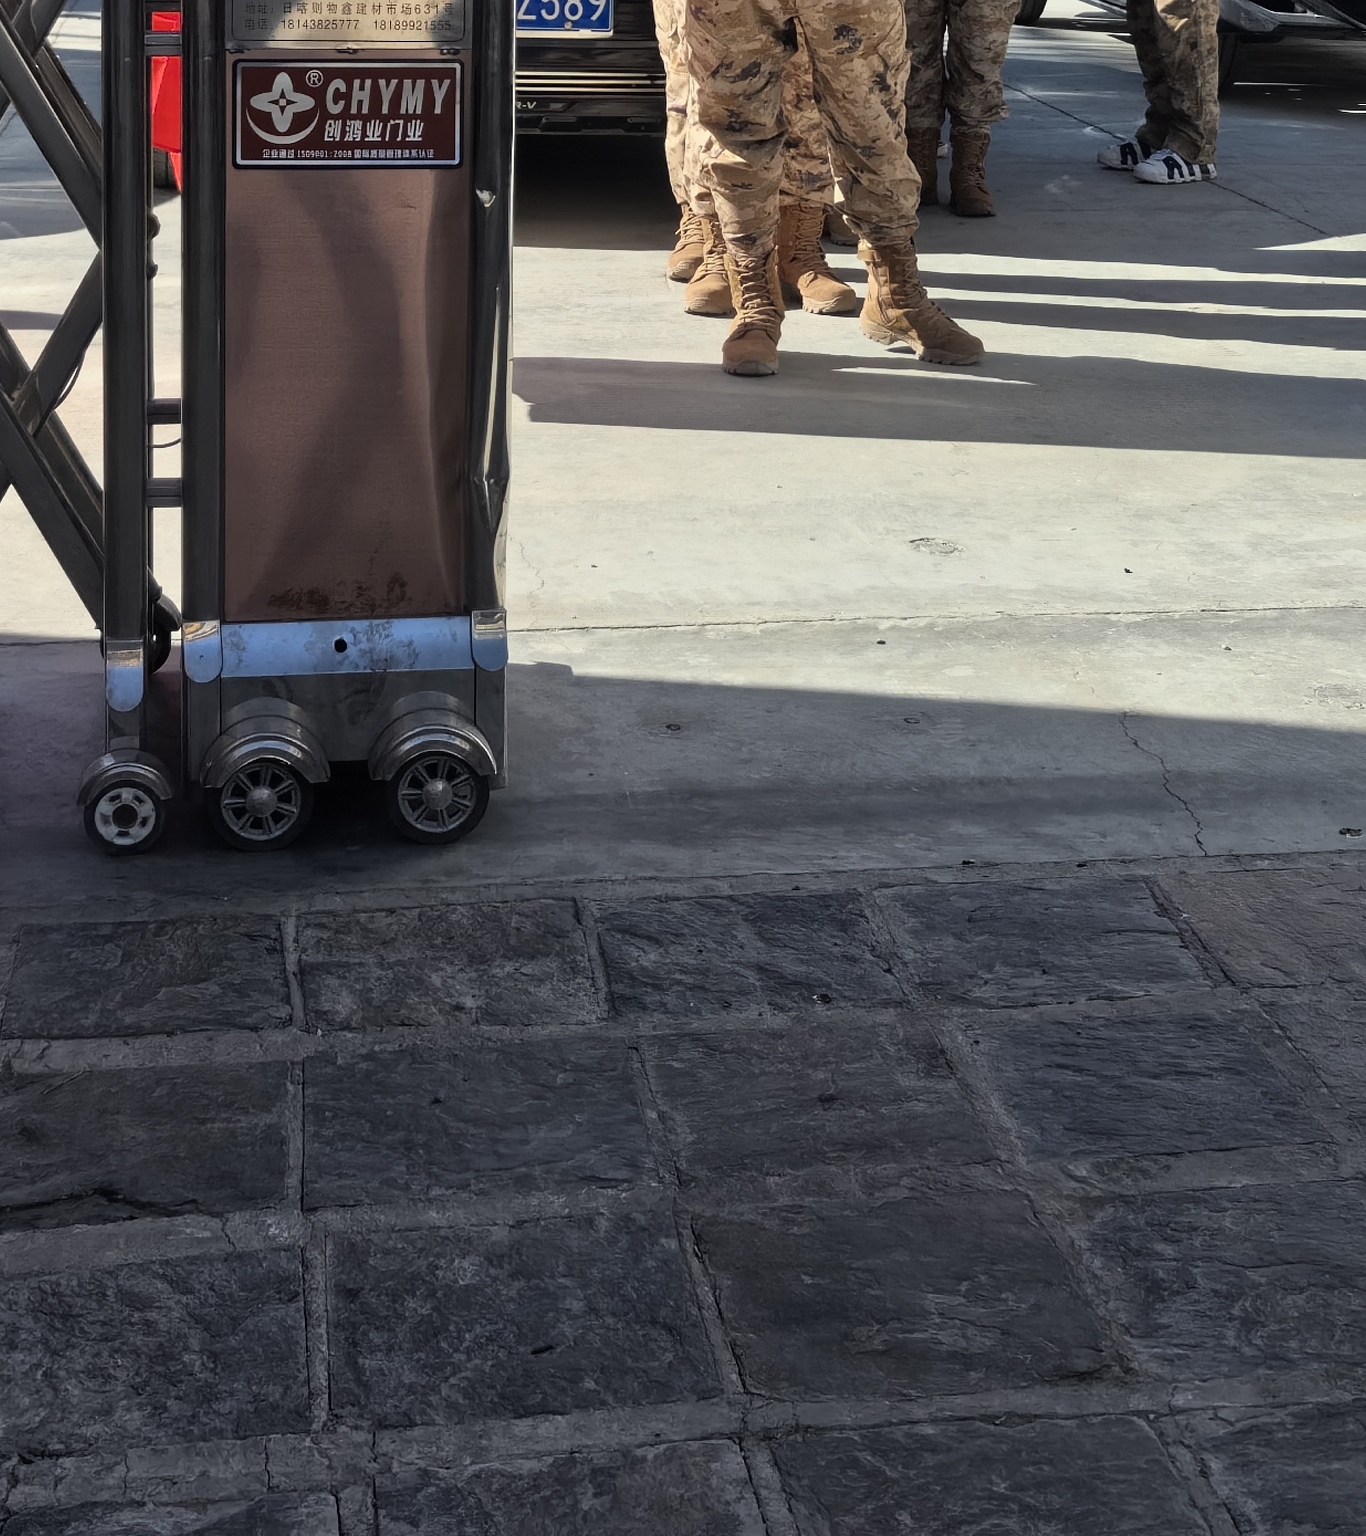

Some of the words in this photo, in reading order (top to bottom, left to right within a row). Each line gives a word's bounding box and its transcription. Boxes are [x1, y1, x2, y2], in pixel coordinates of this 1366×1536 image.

[325, 78, 451, 115] CHYMY
[323, 119, 425, 142] 创鸿业门业
